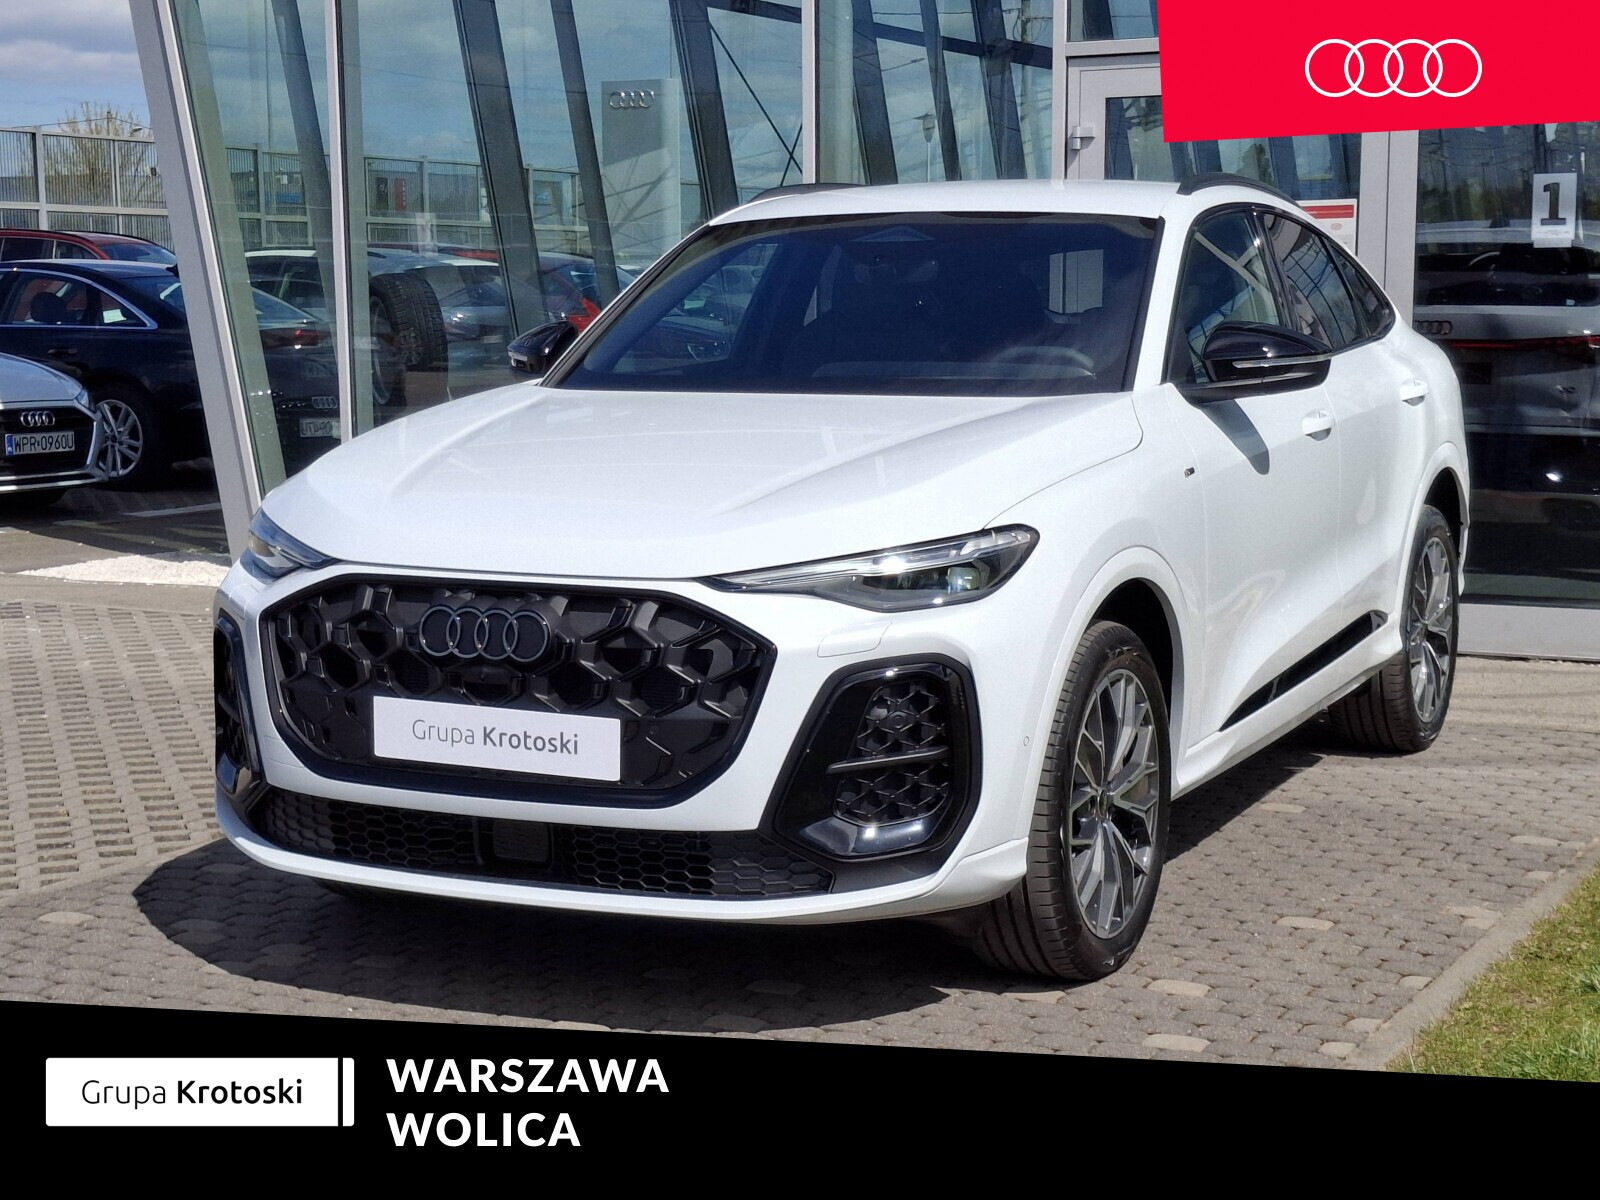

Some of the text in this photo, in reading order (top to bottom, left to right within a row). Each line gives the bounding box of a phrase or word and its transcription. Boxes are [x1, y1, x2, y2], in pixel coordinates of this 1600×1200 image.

[1541, 182, 1567, 226] 1
[411, 719, 579, 755] Grupa Krotoski
